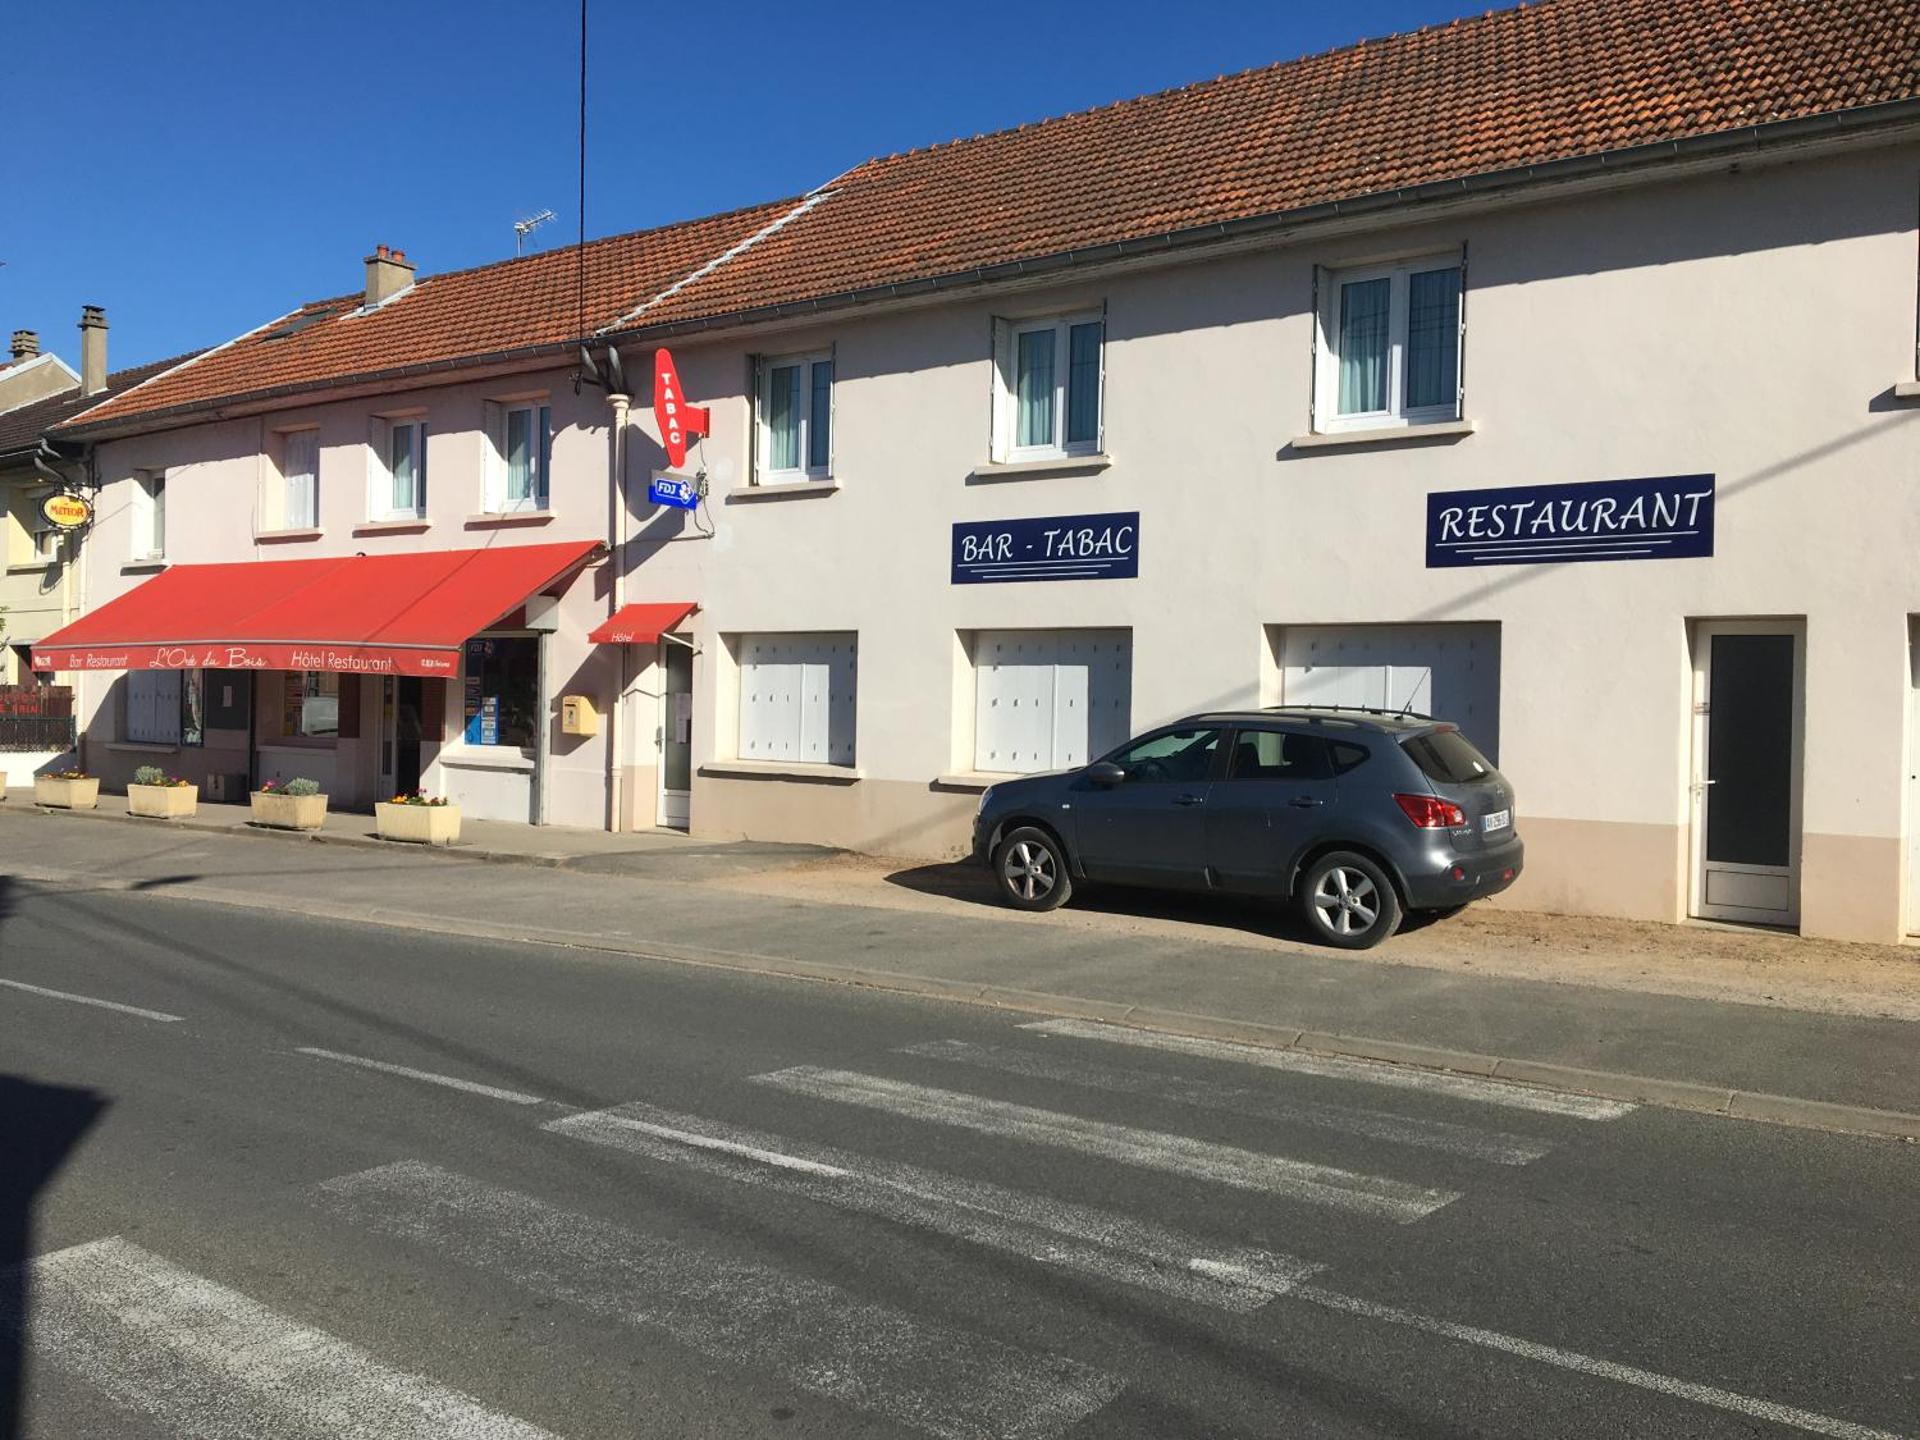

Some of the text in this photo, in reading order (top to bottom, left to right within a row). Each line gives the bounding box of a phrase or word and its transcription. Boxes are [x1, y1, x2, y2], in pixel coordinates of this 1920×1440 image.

[661, 373, 681, 444] TABAC
[657, 482, 676, 495] FDJ
[1439, 489, 1712, 541] RESTAURANT
[961, 533, 1014, 562] BAR
[1044, 526, 1133, 557] TABAC
[69, 653, 83, 668] Bar
[86, 653, 128, 667] Restaurant
[202, 652, 219, 666] du
[225, 647, 267, 668] Bois
[290, 650, 392, 671] Hôtel Restaurant
